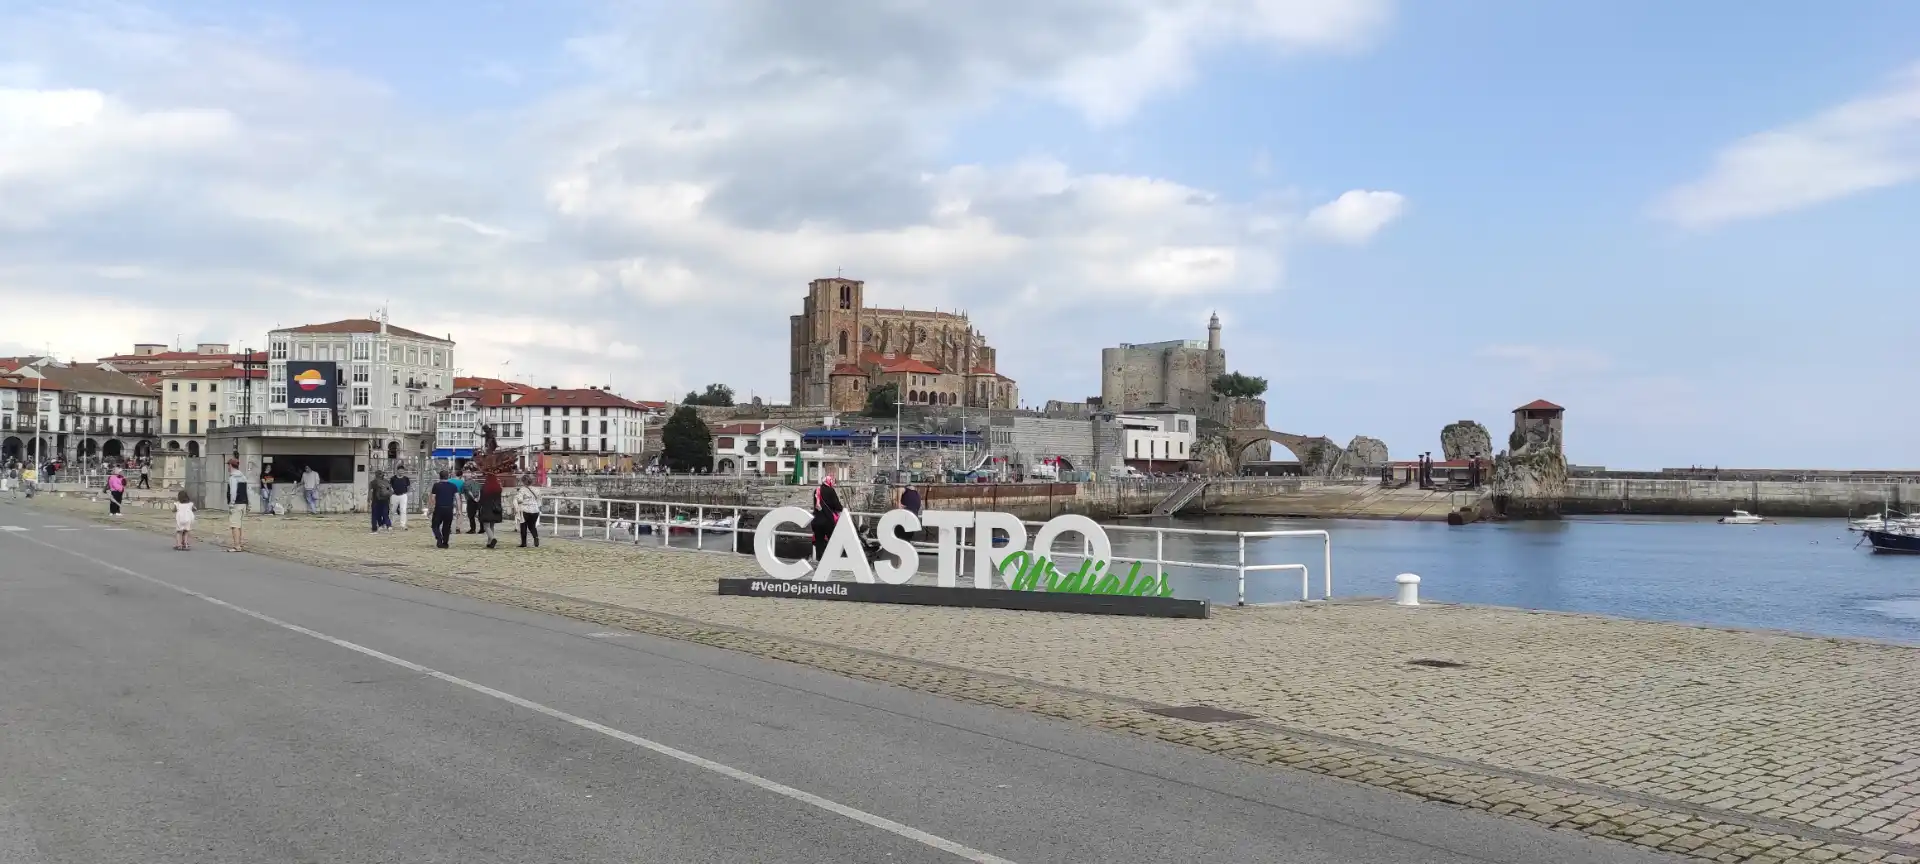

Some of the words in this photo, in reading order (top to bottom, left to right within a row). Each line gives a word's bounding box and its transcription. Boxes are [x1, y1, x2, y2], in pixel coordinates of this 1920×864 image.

[753, 506, 1112, 590] CASTRO
[751, 581, 848, 596] #VenDejaHuella
[999, 550, 1175, 598] Urdiales
